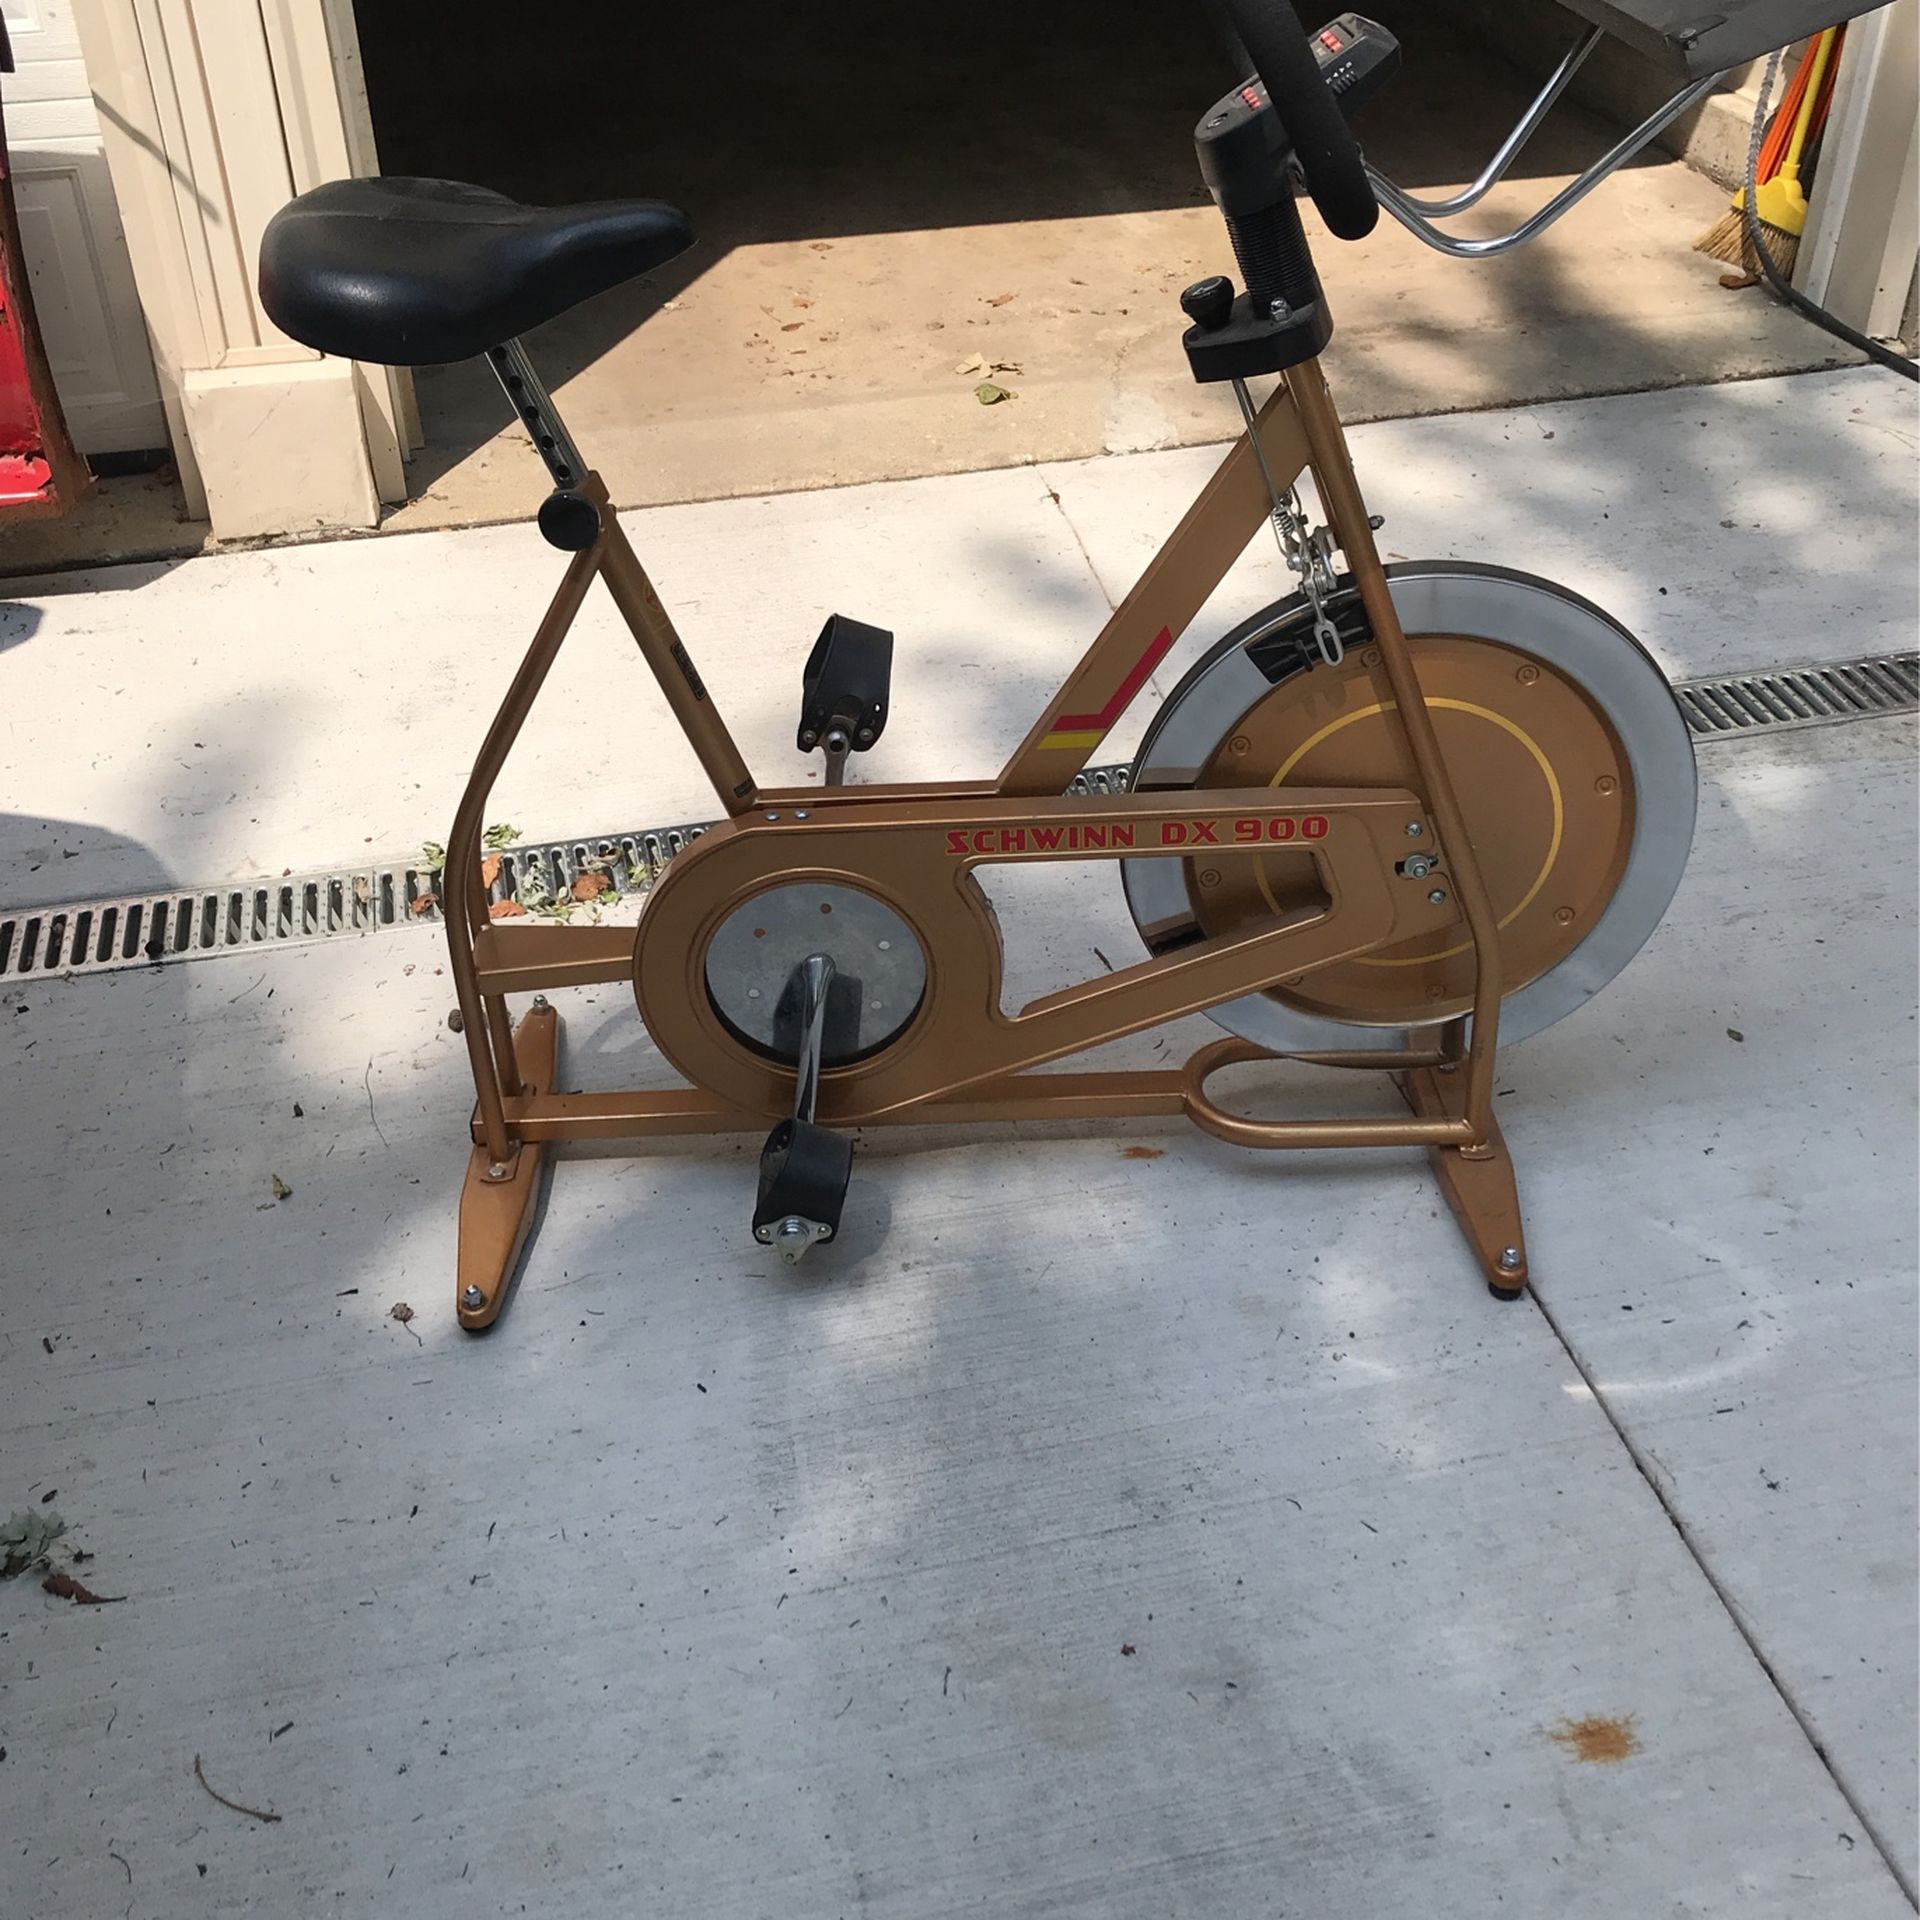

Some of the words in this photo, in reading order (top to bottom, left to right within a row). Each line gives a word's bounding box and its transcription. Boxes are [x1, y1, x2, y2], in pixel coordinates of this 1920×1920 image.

[946, 823, 1135, 854] SCHWINN
[1160, 820, 1219, 846] DX
[1234, 815, 1330, 842] 900
